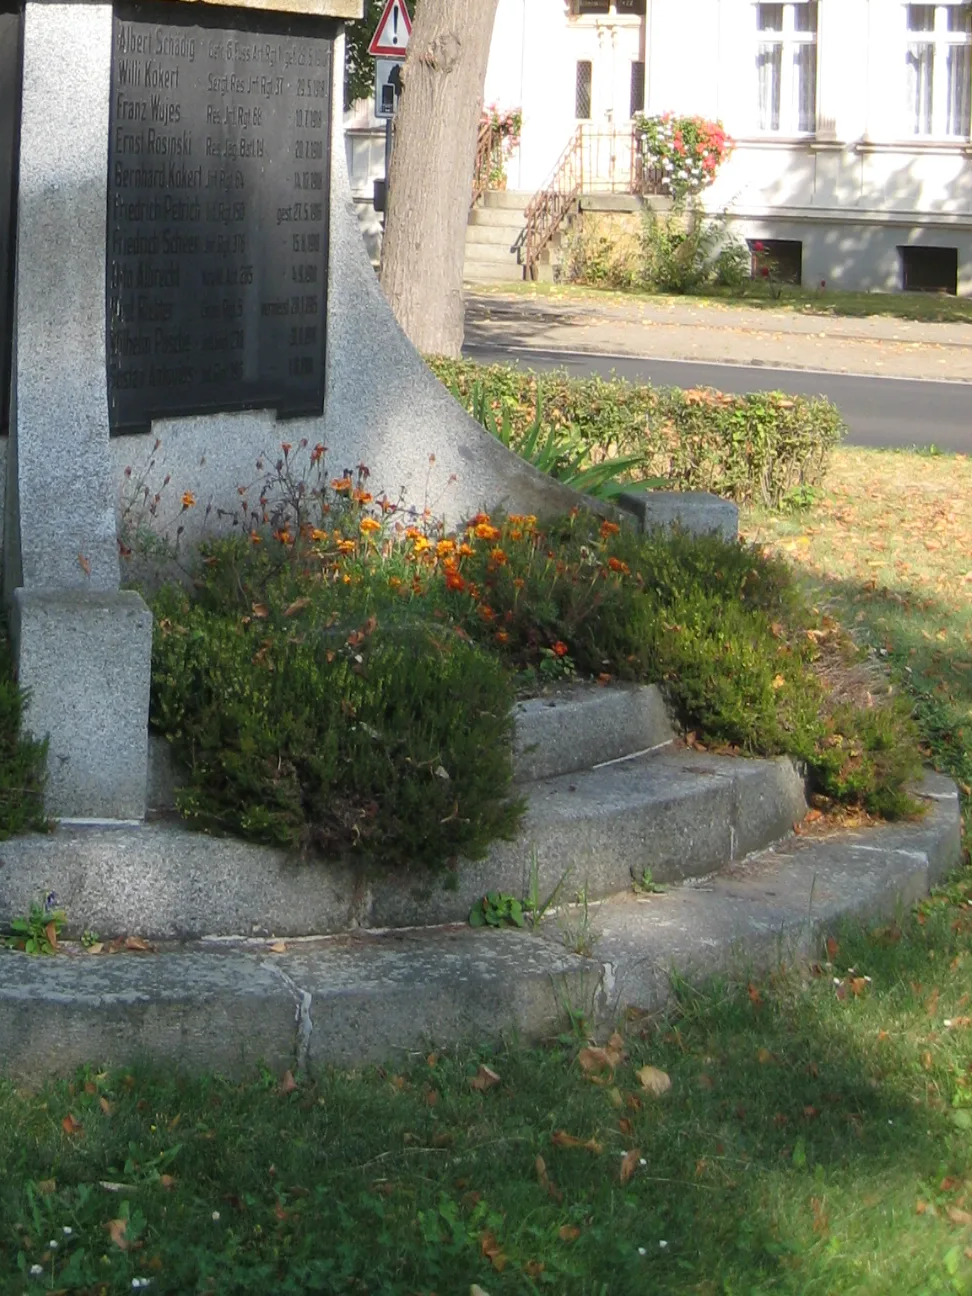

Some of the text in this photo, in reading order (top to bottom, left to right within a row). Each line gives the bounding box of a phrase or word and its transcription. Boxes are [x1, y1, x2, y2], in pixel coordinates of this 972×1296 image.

[117, 25, 152, 54] Albert
[118, 59, 141, 85] Willi
[144, 61, 179, 89] Kokert
[116, 93, 146, 120] Franz
[115, 126, 144, 155] Ernst
[147, 128, 192, 156] Rosinski
[114, 161, 165, 188] Bernhard
[169, 161, 202, 190] Kokert
[113, 194, 161, 221] Friedrich
[112, 228, 157, 255] Friedrich
